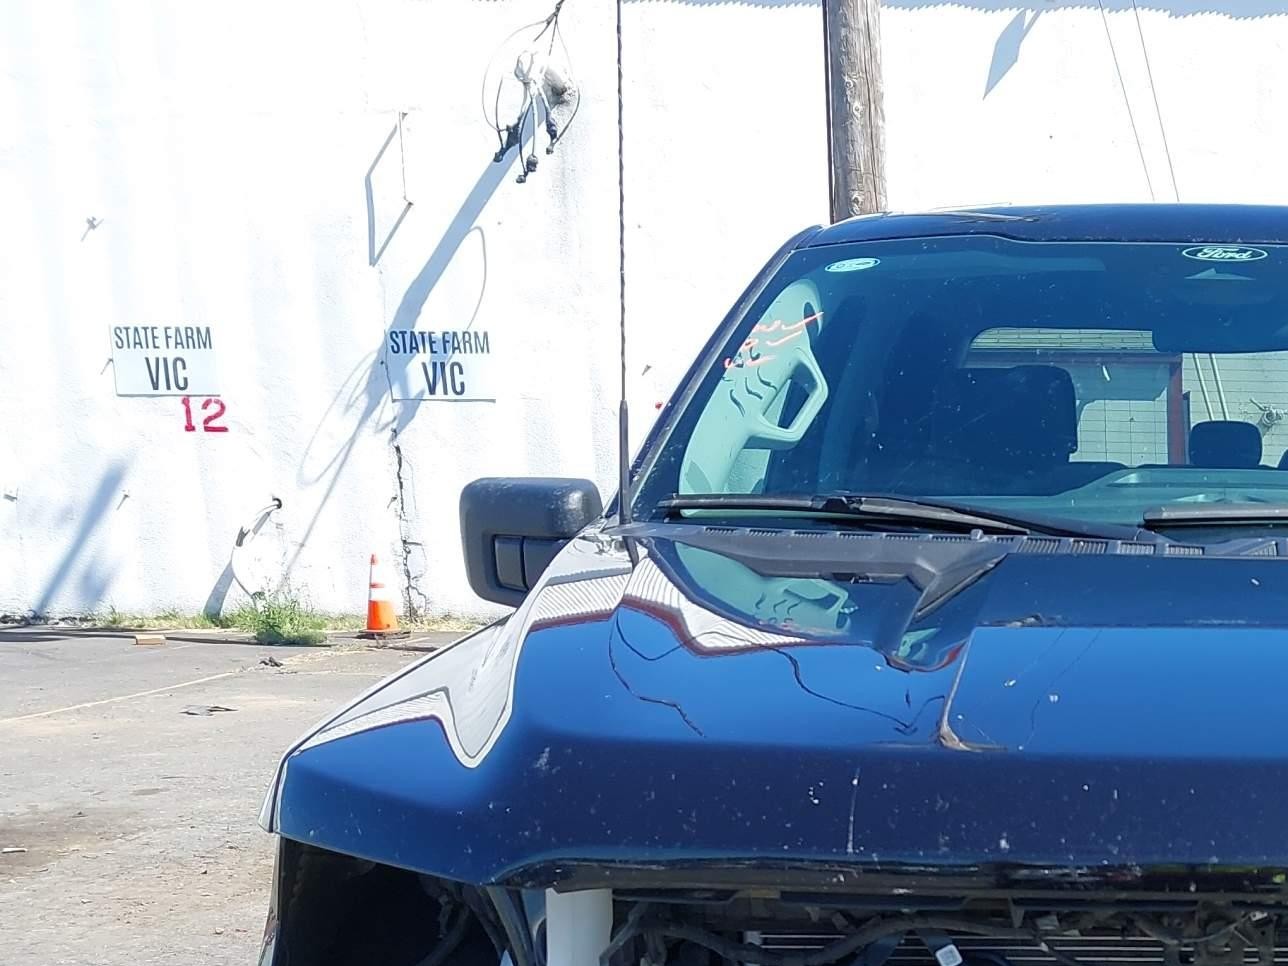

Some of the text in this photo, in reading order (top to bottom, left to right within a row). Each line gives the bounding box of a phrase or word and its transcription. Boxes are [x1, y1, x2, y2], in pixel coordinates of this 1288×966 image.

[1196, 246, 1253, 260] Ford
[114, 326, 212, 350] STATE FARM
[389, 330, 490, 354] STATE FARM
[144, 356, 189, 391] VIC
[421, 361, 465, 396] VIC
[181, 397, 229, 432] 12
